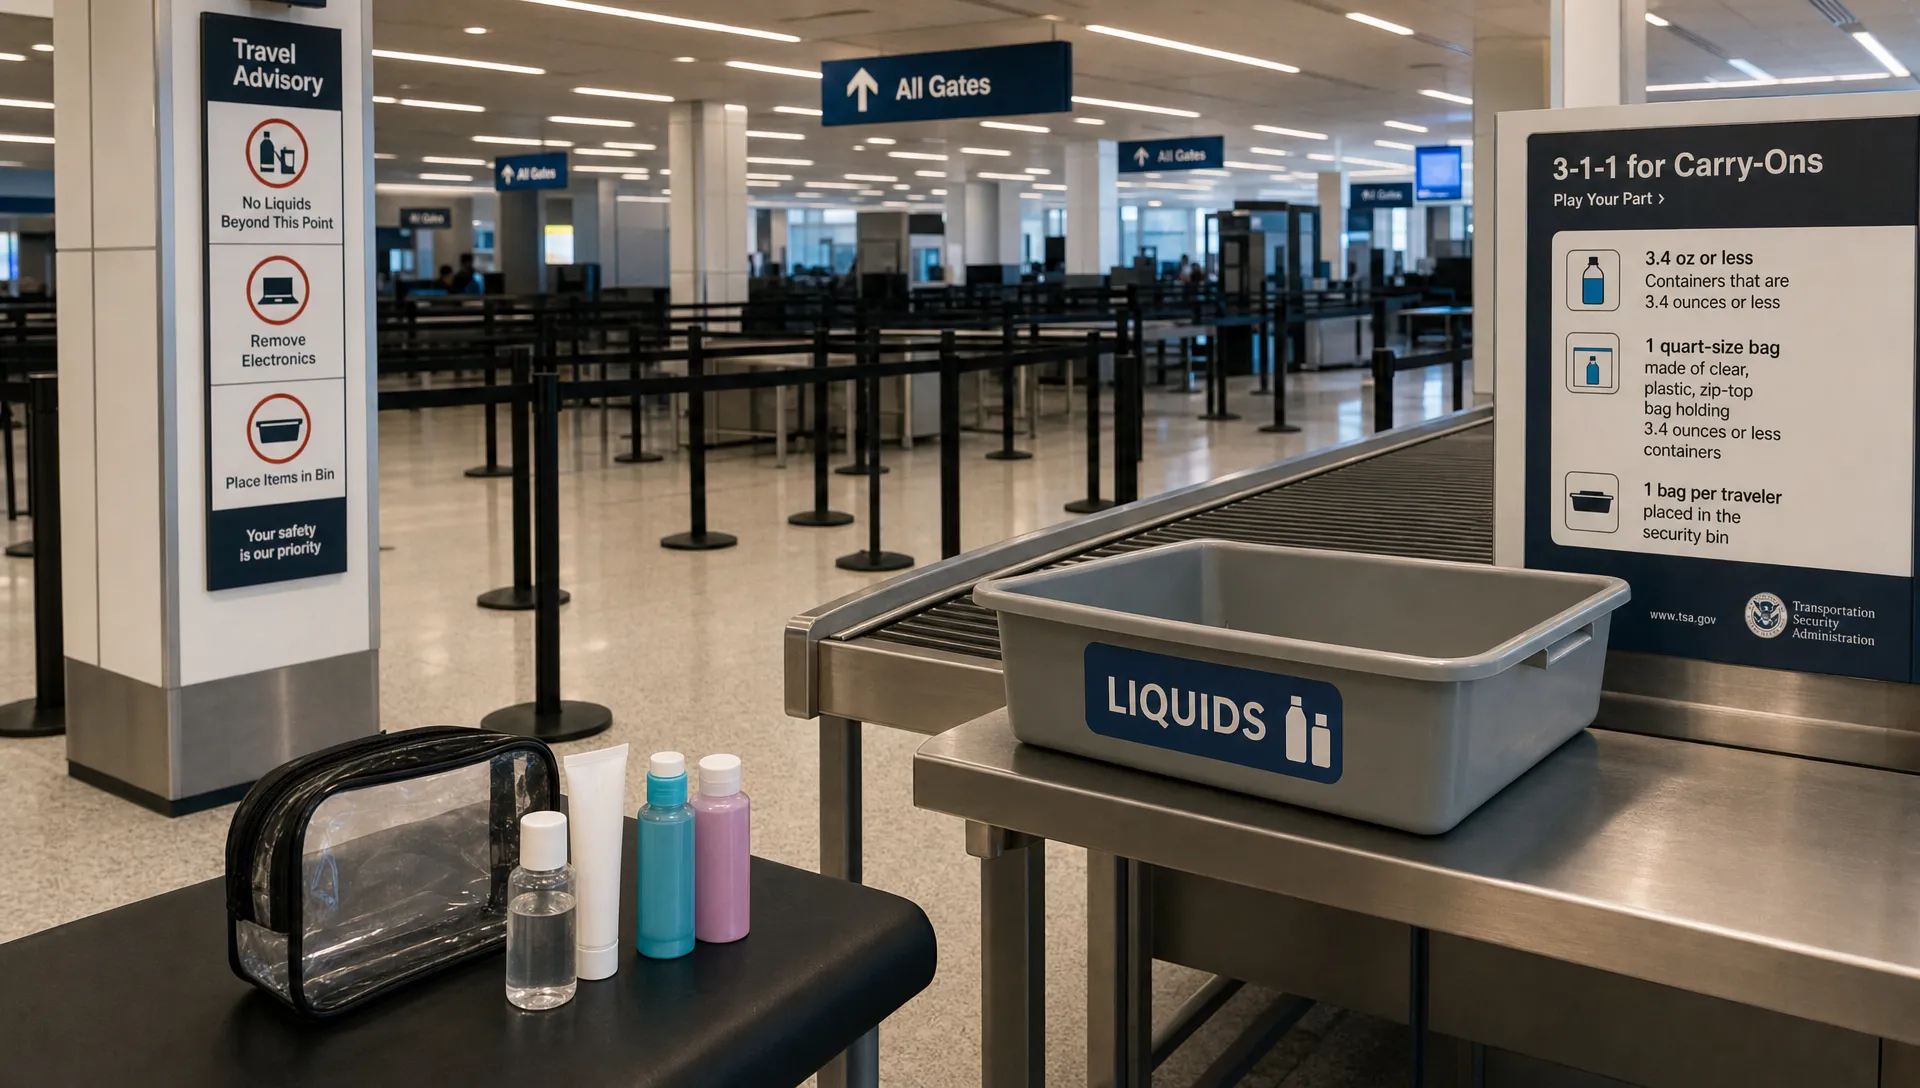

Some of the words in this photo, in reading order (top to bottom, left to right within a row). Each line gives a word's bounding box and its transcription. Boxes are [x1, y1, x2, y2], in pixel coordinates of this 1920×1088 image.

[233, 38, 295, 64] Travel
[233, 65, 323, 97] Advisory
[896, 77, 922, 100] All
[929, 75, 991, 97] Gates
[1158, 149, 1173, 163] All
[1175, 148, 1206, 162] Gates
[1553, 156, 1615, 180] 3-1-1
[1627, 154, 1665, 178] for
[1675, 149, 1823, 182] Carry-Ons
[243, 196, 261, 209] No
[265, 197, 311, 213] Liquids
[1554, 194, 1583, 209] Play
[1587, 193, 1619, 205] Your
[1624, 192, 1652, 205] Part
[222, 215, 269, 231] Beyond
[273, 216, 299, 228] This
[303, 217, 333, 229] Point
[1646, 251, 1671, 265] 3.4
[1676, 254, 1694, 265] oz
[1700, 254, 1717, 265] or
[1723, 250, 1753, 264] less
[1646, 274, 1725, 287] Containers
[1730, 274, 1760, 287] that
[1765, 277, 1789, 287] are
[1646, 295, 1668, 308] 3.4
[1673, 298, 1726, 308] ounces
[1731, 298, 1746, 308] or
[1752, 295, 1780, 309] less
[251, 335, 305, 347] Remove
[1646, 338, 1652, 352] 1
[1661, 339, 1743, 356] quart-size
[1750, 340, 1779, 358] bag
[243, 352, 315, 367] Electronics
[1645, 361, 1685, 374] made
[1691, 361, 1705, 375] of
[1710, 362, 1748, 378] clear,
[1645, 381, 1695, 398] plastic,
[1700, 385, 1753, 400] zip-top
[1645, 401, 1671, 418] bag
[1677, 402, 1729, 421] holding
[1645, 422, 1668, 435] 3.4
[1673, 426, 1726, 438] ounces
[1731, 429, 1746, 438] or
[1752, 426, 1781, 440] less
[1644, 444, 1721, 459] containers
[226, 476, 260, 489] Place
[264, 474, 298, 486] Items
[302, 470, 311, 482] in
[316, 469, 334, 480] Bin
[1645, 482, 1650, 496] 1
[1658, 483, 1685, 502] bag
[1691, 489, 1717, 502] per
[1721, 488, 1782, 504] traveler
[1644, 504, 1692, 520] placed
[1698, 508, 1711, 522] in
[1716, 509, 1740, 523] the
[247, 529, 276, 542] Your
[279, 524, 316, 539] safety
[1643, 528, 1701, 545] security
[1706, 529, 1728, 544] bin
[240, 549, 250, 561] is
[254, 548, 275, 559] our
[278, 541, 321, 560] priority
[1793, 601, 1875, 618] Transportation
[1650, 612, 1716, 626] www.tsa.gov
[1793, 614, 1839, 631] Security
[1792, 628, 1874, 645] Administration
[1109, 676, 1266, 742] LIQUIDS
